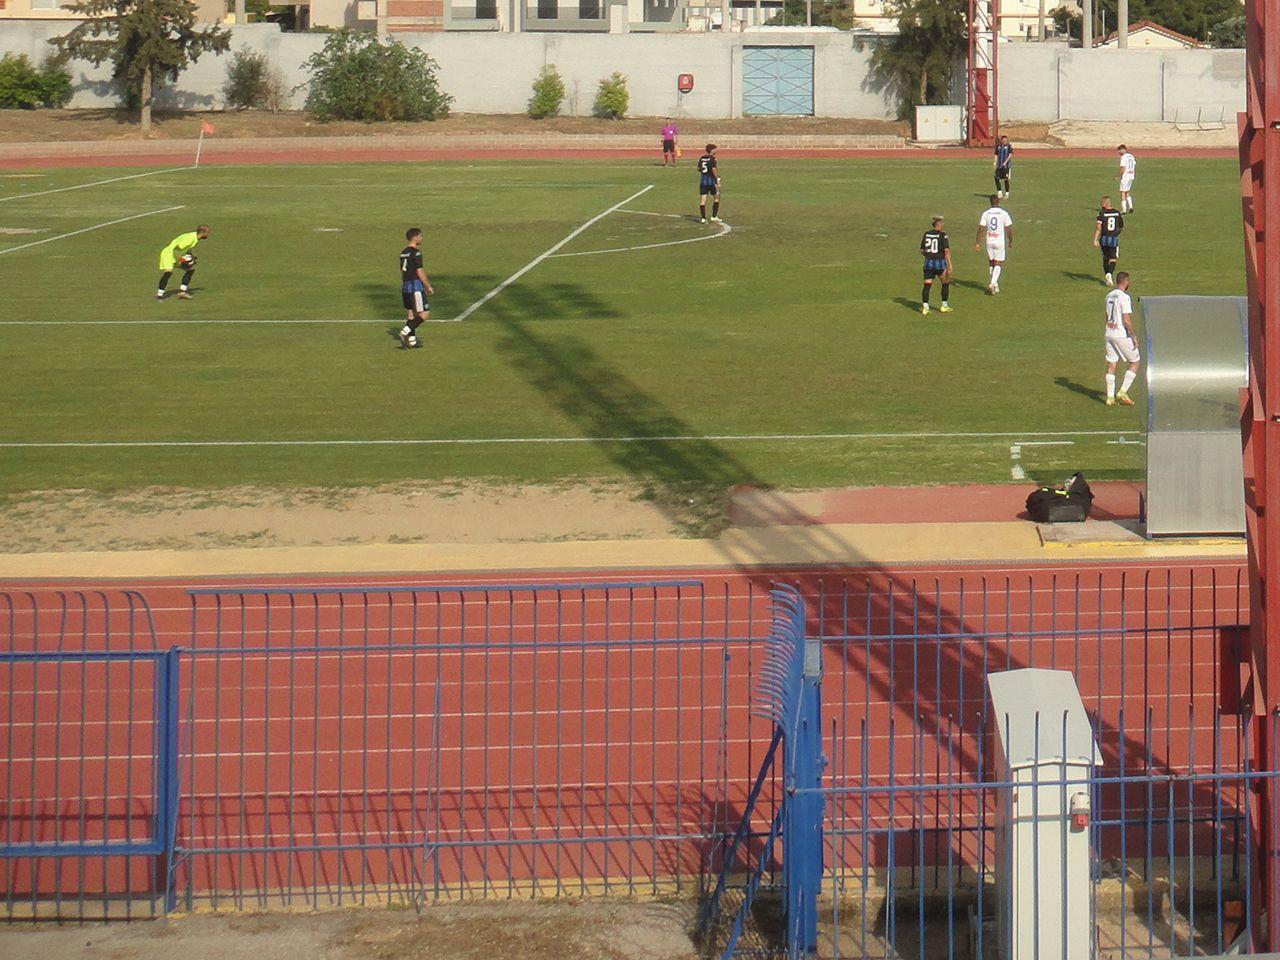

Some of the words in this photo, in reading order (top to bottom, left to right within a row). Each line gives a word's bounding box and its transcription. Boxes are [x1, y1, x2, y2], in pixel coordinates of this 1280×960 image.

[702, 161, 708, 173] 5
[990, 216, 998, 230] 9
[1107, 217, 1115, 231] 8
[925, 238, 938, 253] 20
[1108, 301, 1114, 320] 7
